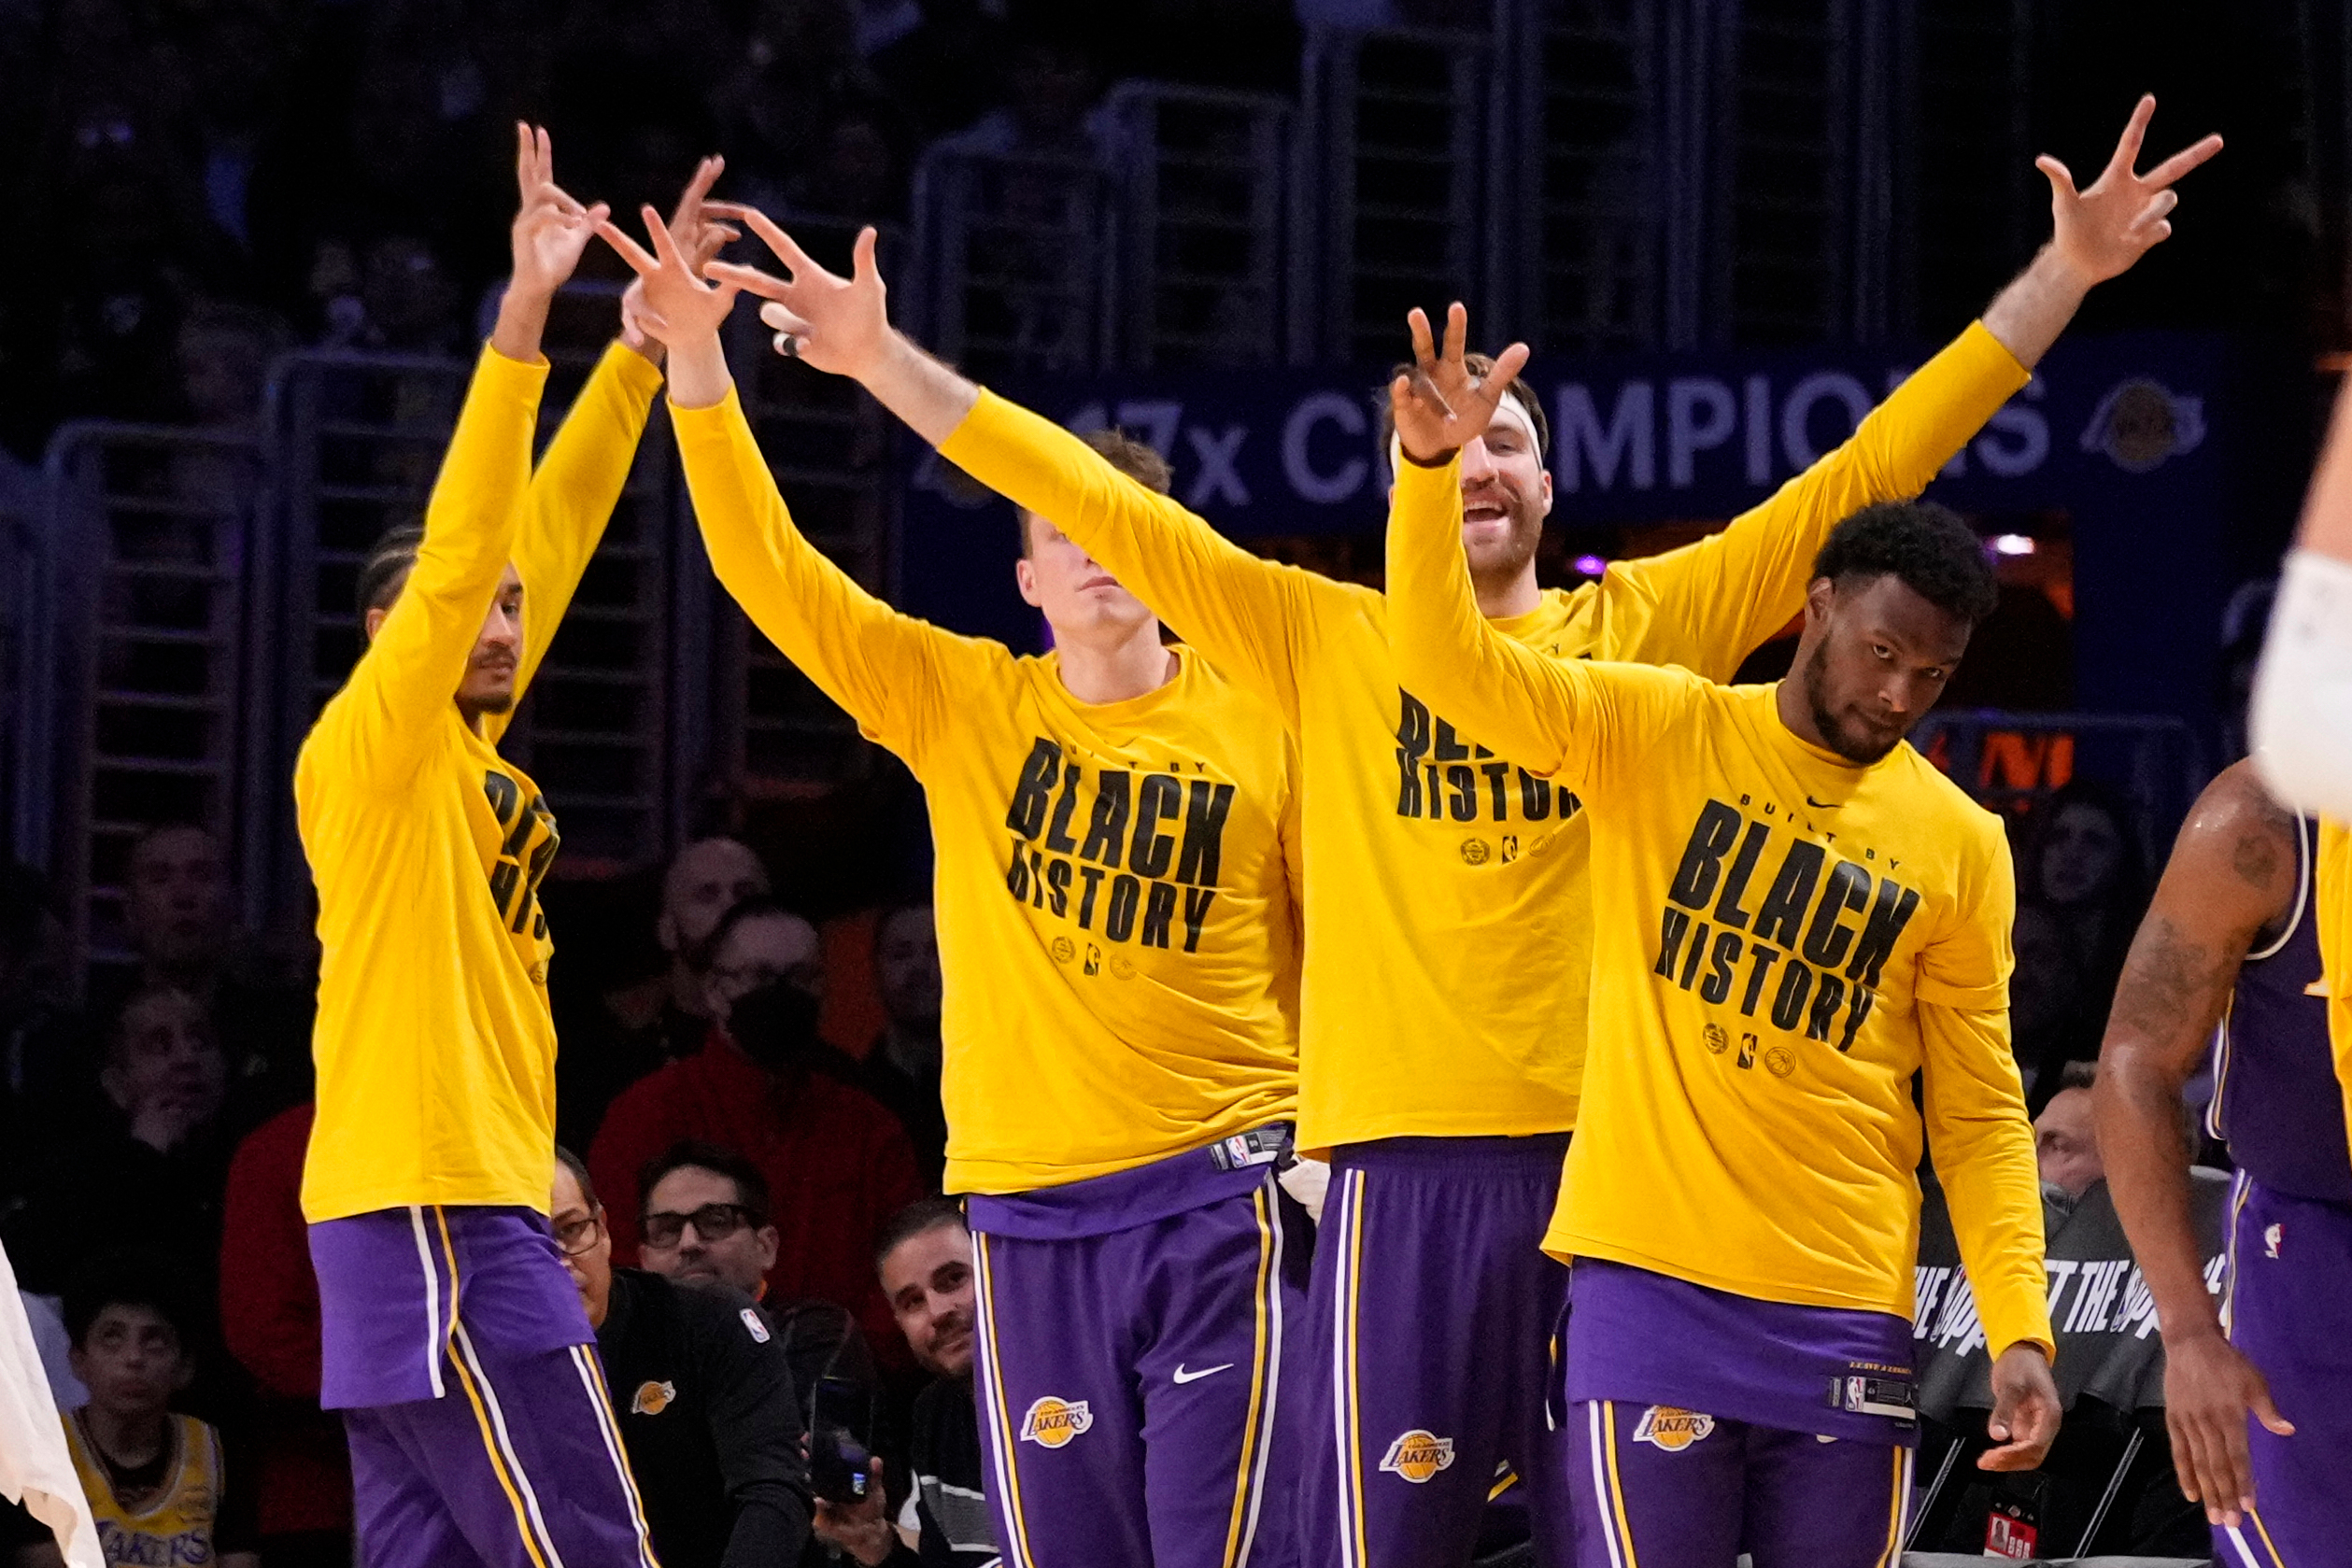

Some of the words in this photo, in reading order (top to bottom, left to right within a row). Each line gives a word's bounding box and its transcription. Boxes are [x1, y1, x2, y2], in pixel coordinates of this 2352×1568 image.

[1067, 398, 1252, 507] 7x
[1282, 370, 2051, 505] CMPIOS
[1006, 737, 1236, 887] BLACK
[1396, 747, 1582, 823] HISTO
[1740, 793, 1837, 843] BUILT
[1864, 847, 1900, 870] BY
[1007, 839, 1217, 953] HISTORY
[1668, 798, 1920, 988] BLACK
[1654, 905, 1874, 1052] HISTORY
[2062, 1260, 2130, 1333] THE
[1025, 1410, 1086, 1437] LAKERS
[1383, 1443, 1452, 1468] LAKERS
[1639, 1413, 1708, 1437] LAKERS
